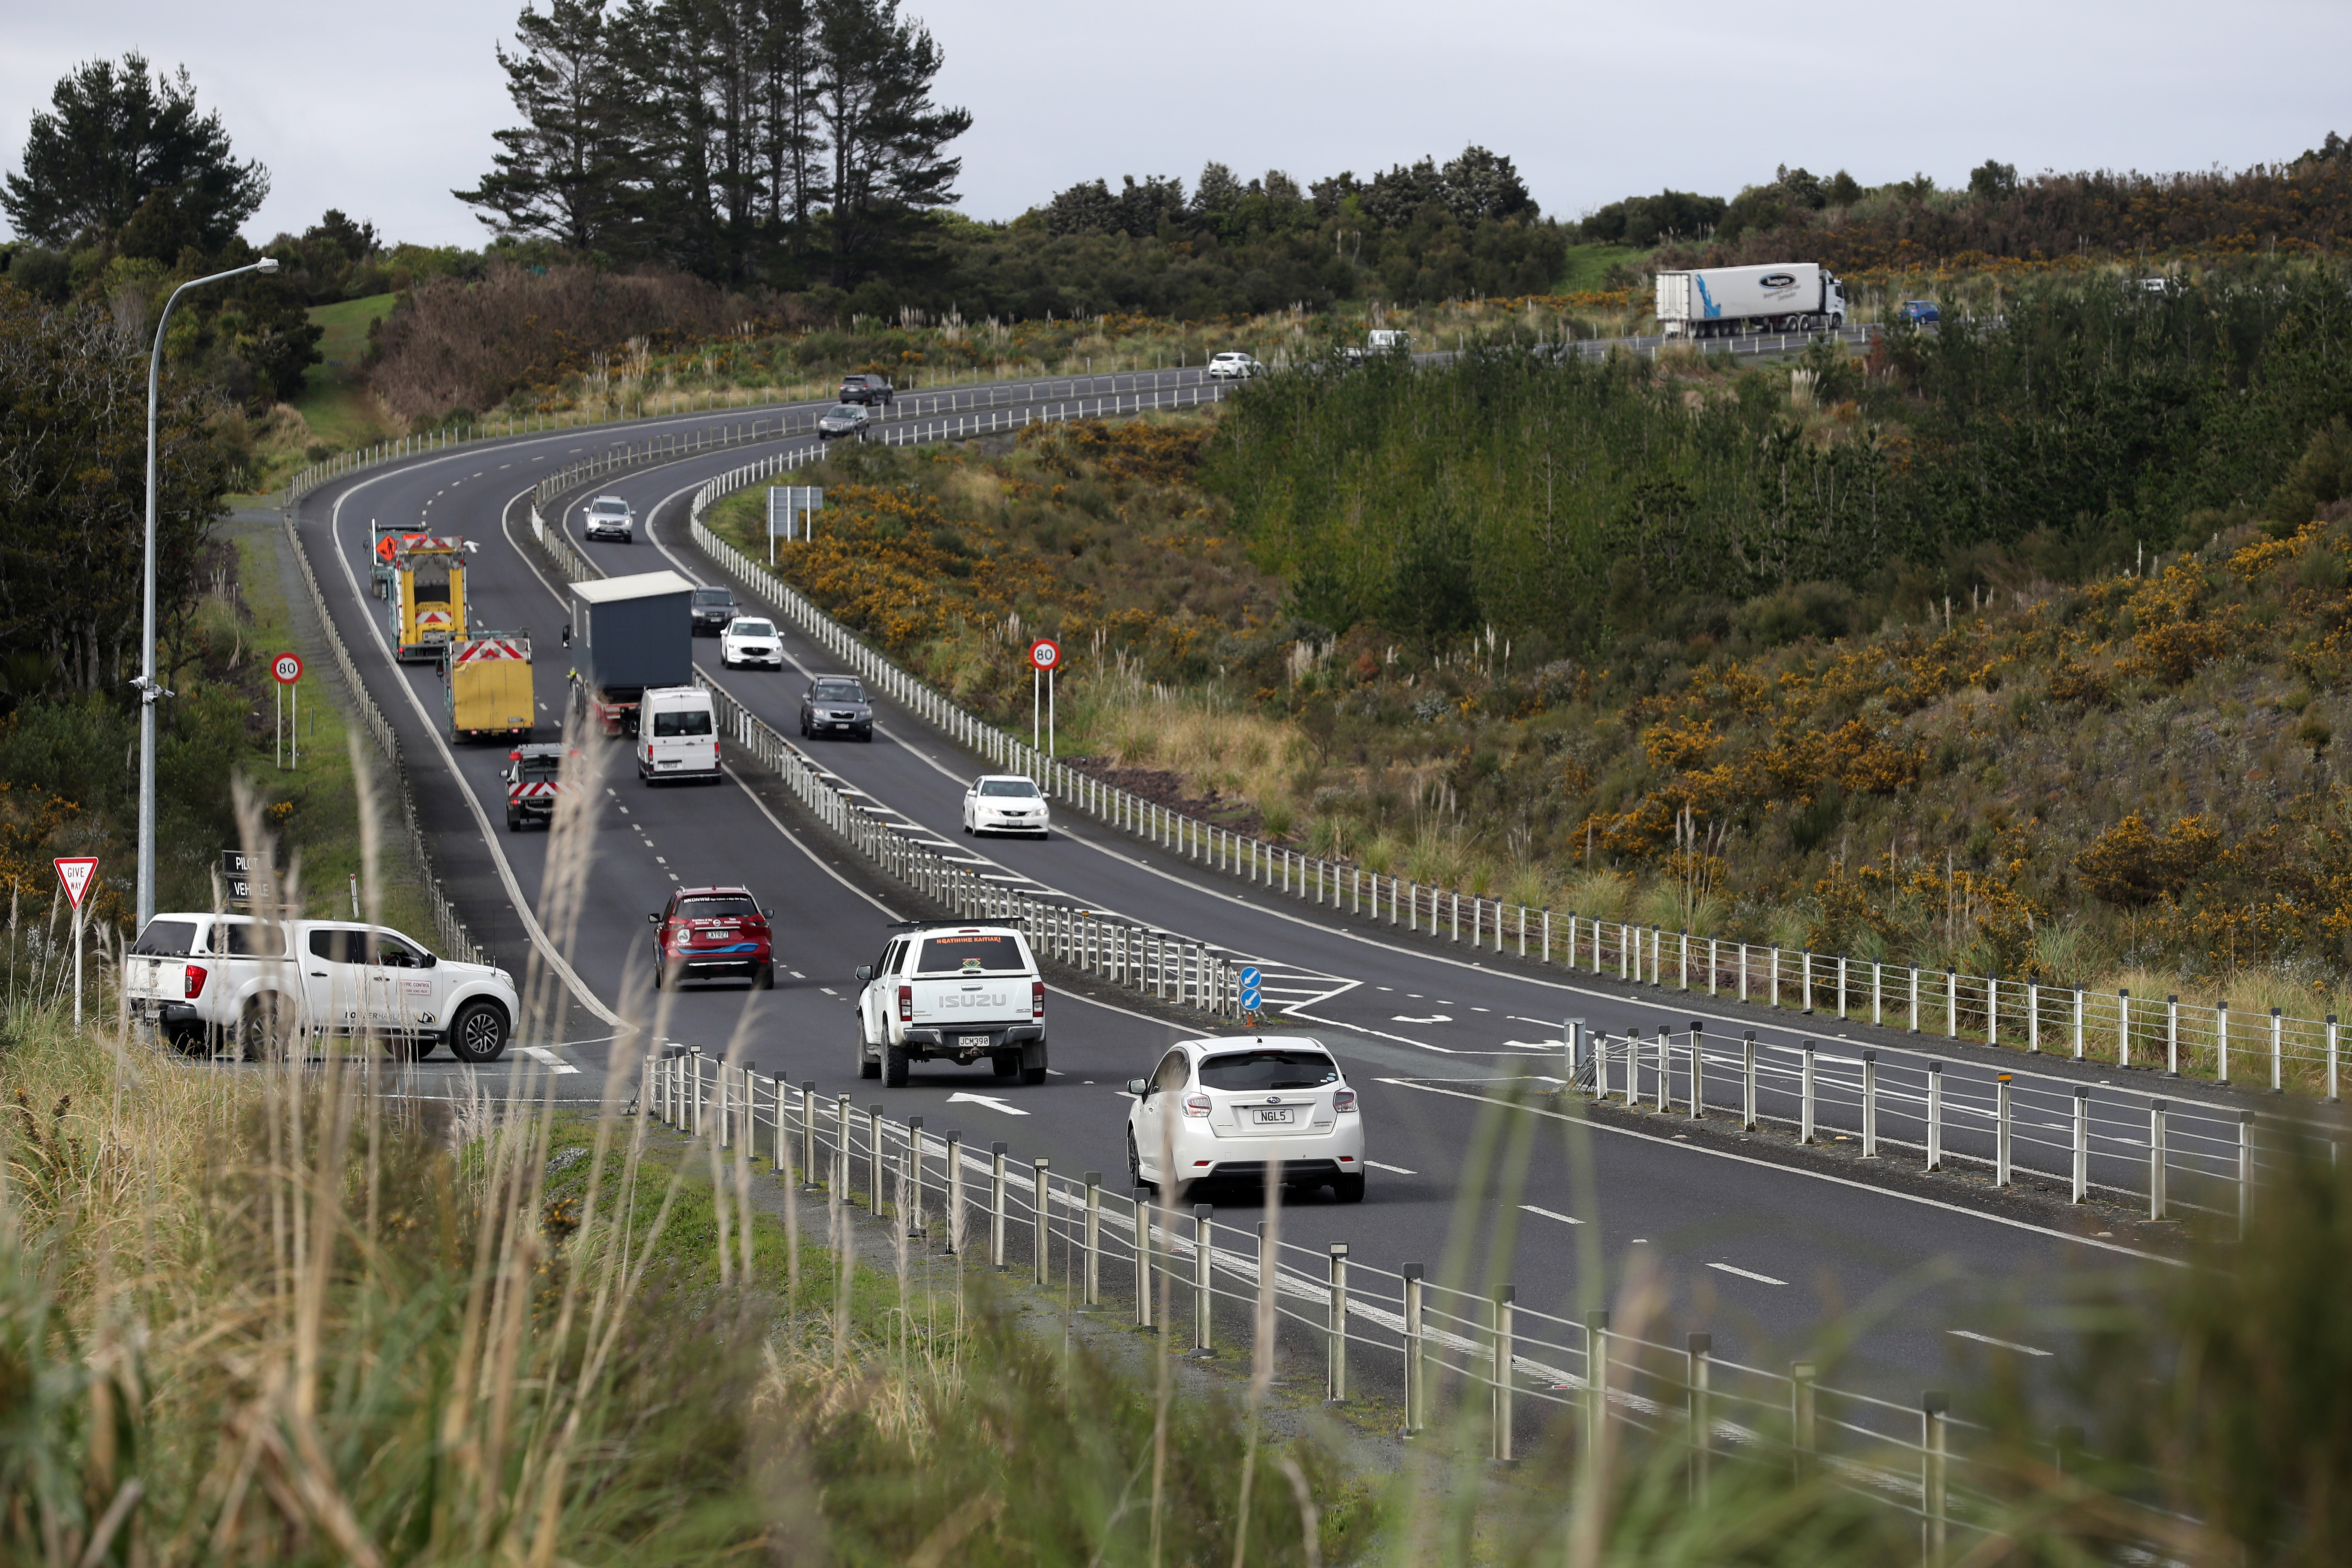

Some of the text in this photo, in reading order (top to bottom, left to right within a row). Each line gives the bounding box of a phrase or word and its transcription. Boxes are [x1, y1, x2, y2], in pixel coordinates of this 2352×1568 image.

[1037, 649, 1052, 660] 80
[279, 662, 295, 674] 80
[236, 856, 258, 870] PILOT
[67, 867, 84, 878] GIVE
[70, 882, 81, 890] WAY
[234, 882, 269, 897] VEHLE
[939, 994, 1006, 1008] ISUZU
[960, 1037, 989, 1045] JCM390
[1261, 1111, 1286, 1121] NGL5
